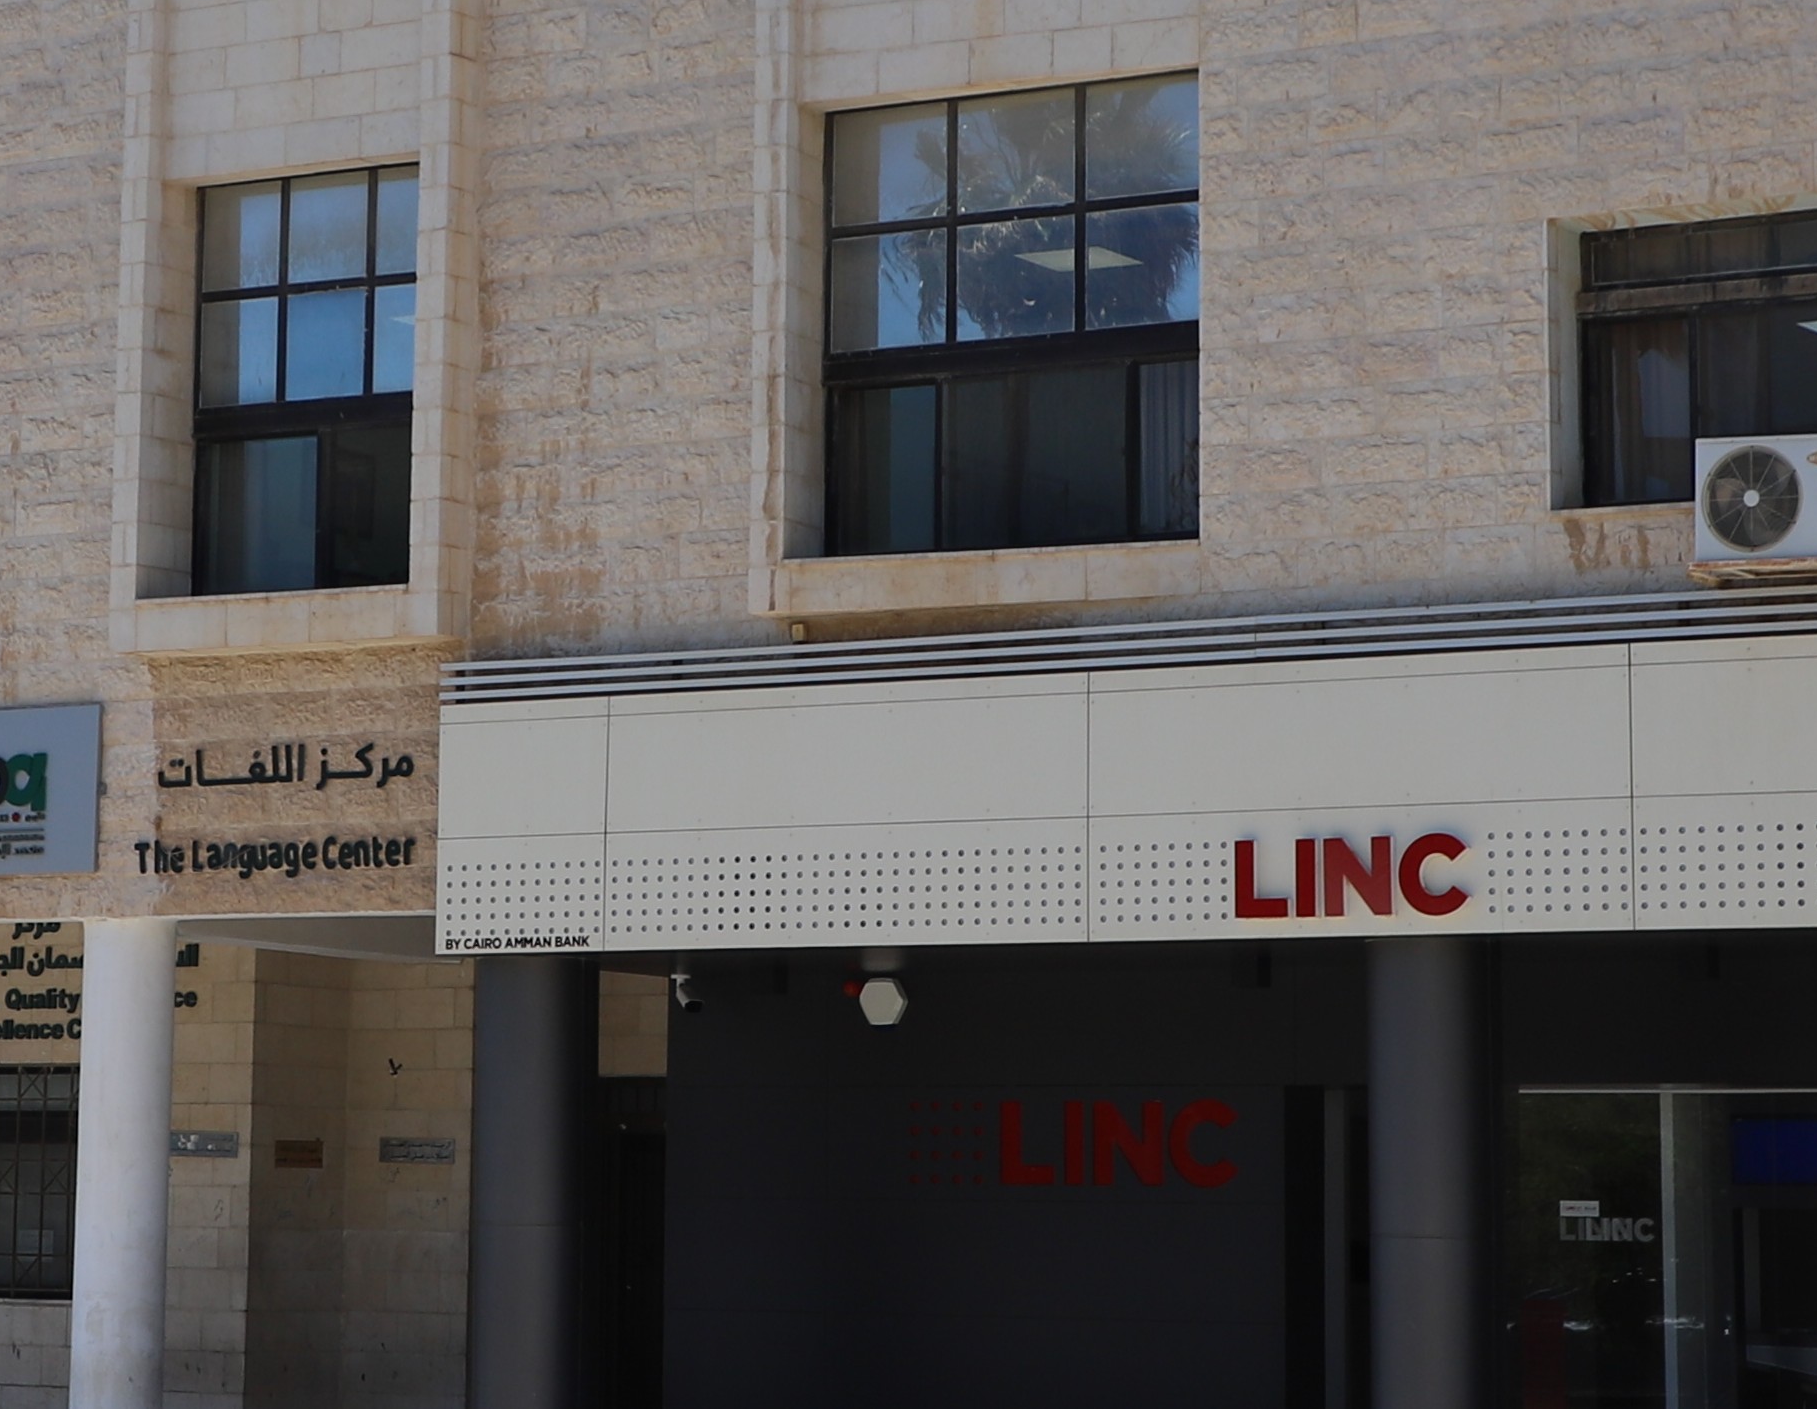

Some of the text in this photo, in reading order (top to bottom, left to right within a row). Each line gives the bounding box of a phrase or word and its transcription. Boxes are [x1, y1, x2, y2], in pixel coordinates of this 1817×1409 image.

[157, 742, 415, 790] مركز اللغات
[134, 835, 416, 879] The Language Center
[1234, 832, 1472, 919] LINC
[445, 935, 590, 950] BY CAIRO AMMAN BANK
[5, 987, 81, 1014] Quality
[1000, 1098, 1239, 1188] LINC
